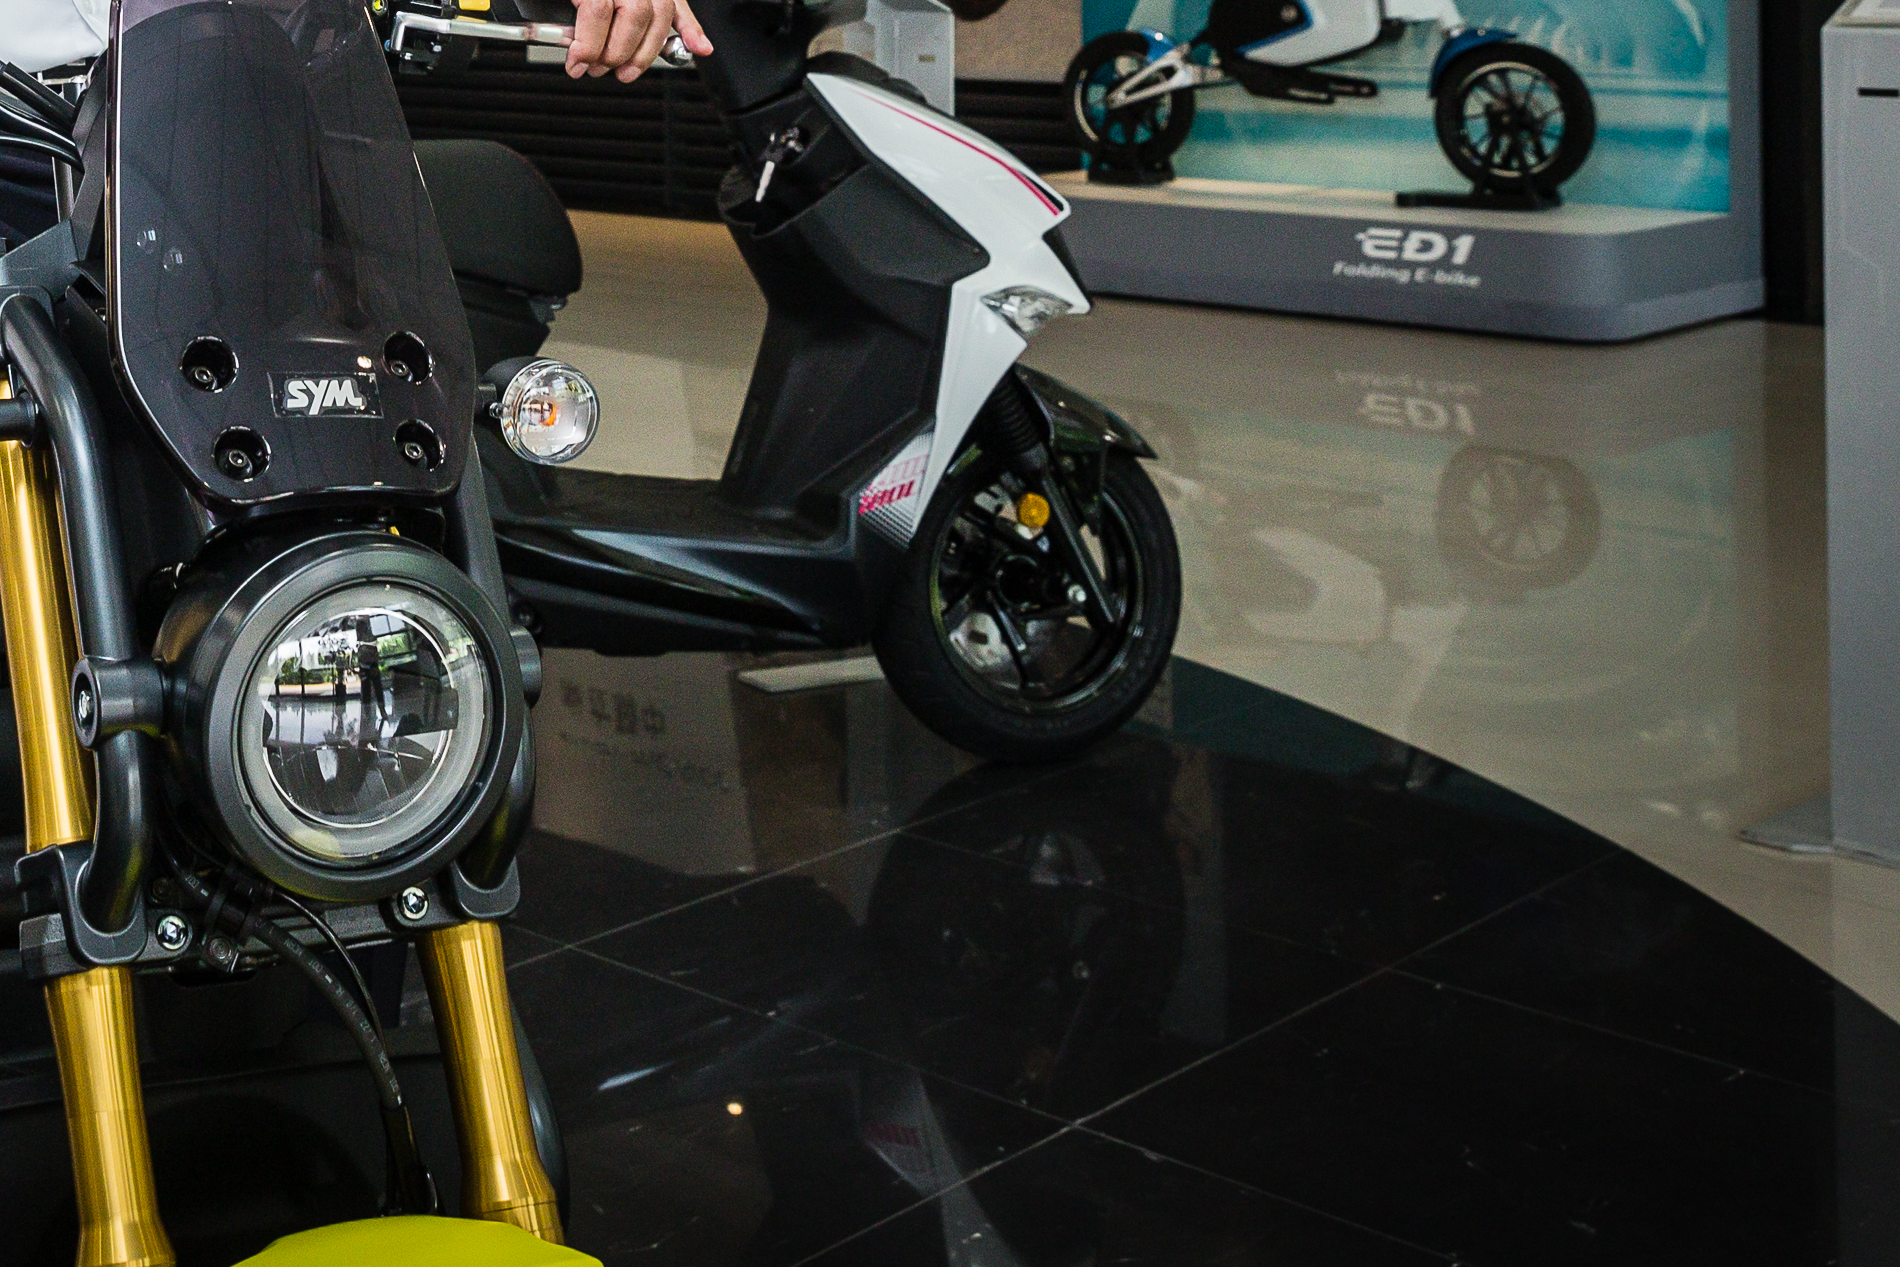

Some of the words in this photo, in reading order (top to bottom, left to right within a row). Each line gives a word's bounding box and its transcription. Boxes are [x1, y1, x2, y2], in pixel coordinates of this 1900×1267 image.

[1355, 227, 1476, 265] ED1
[1332, 261, 1411, 284] Folding
[287, 379, 363, 415] SYM
